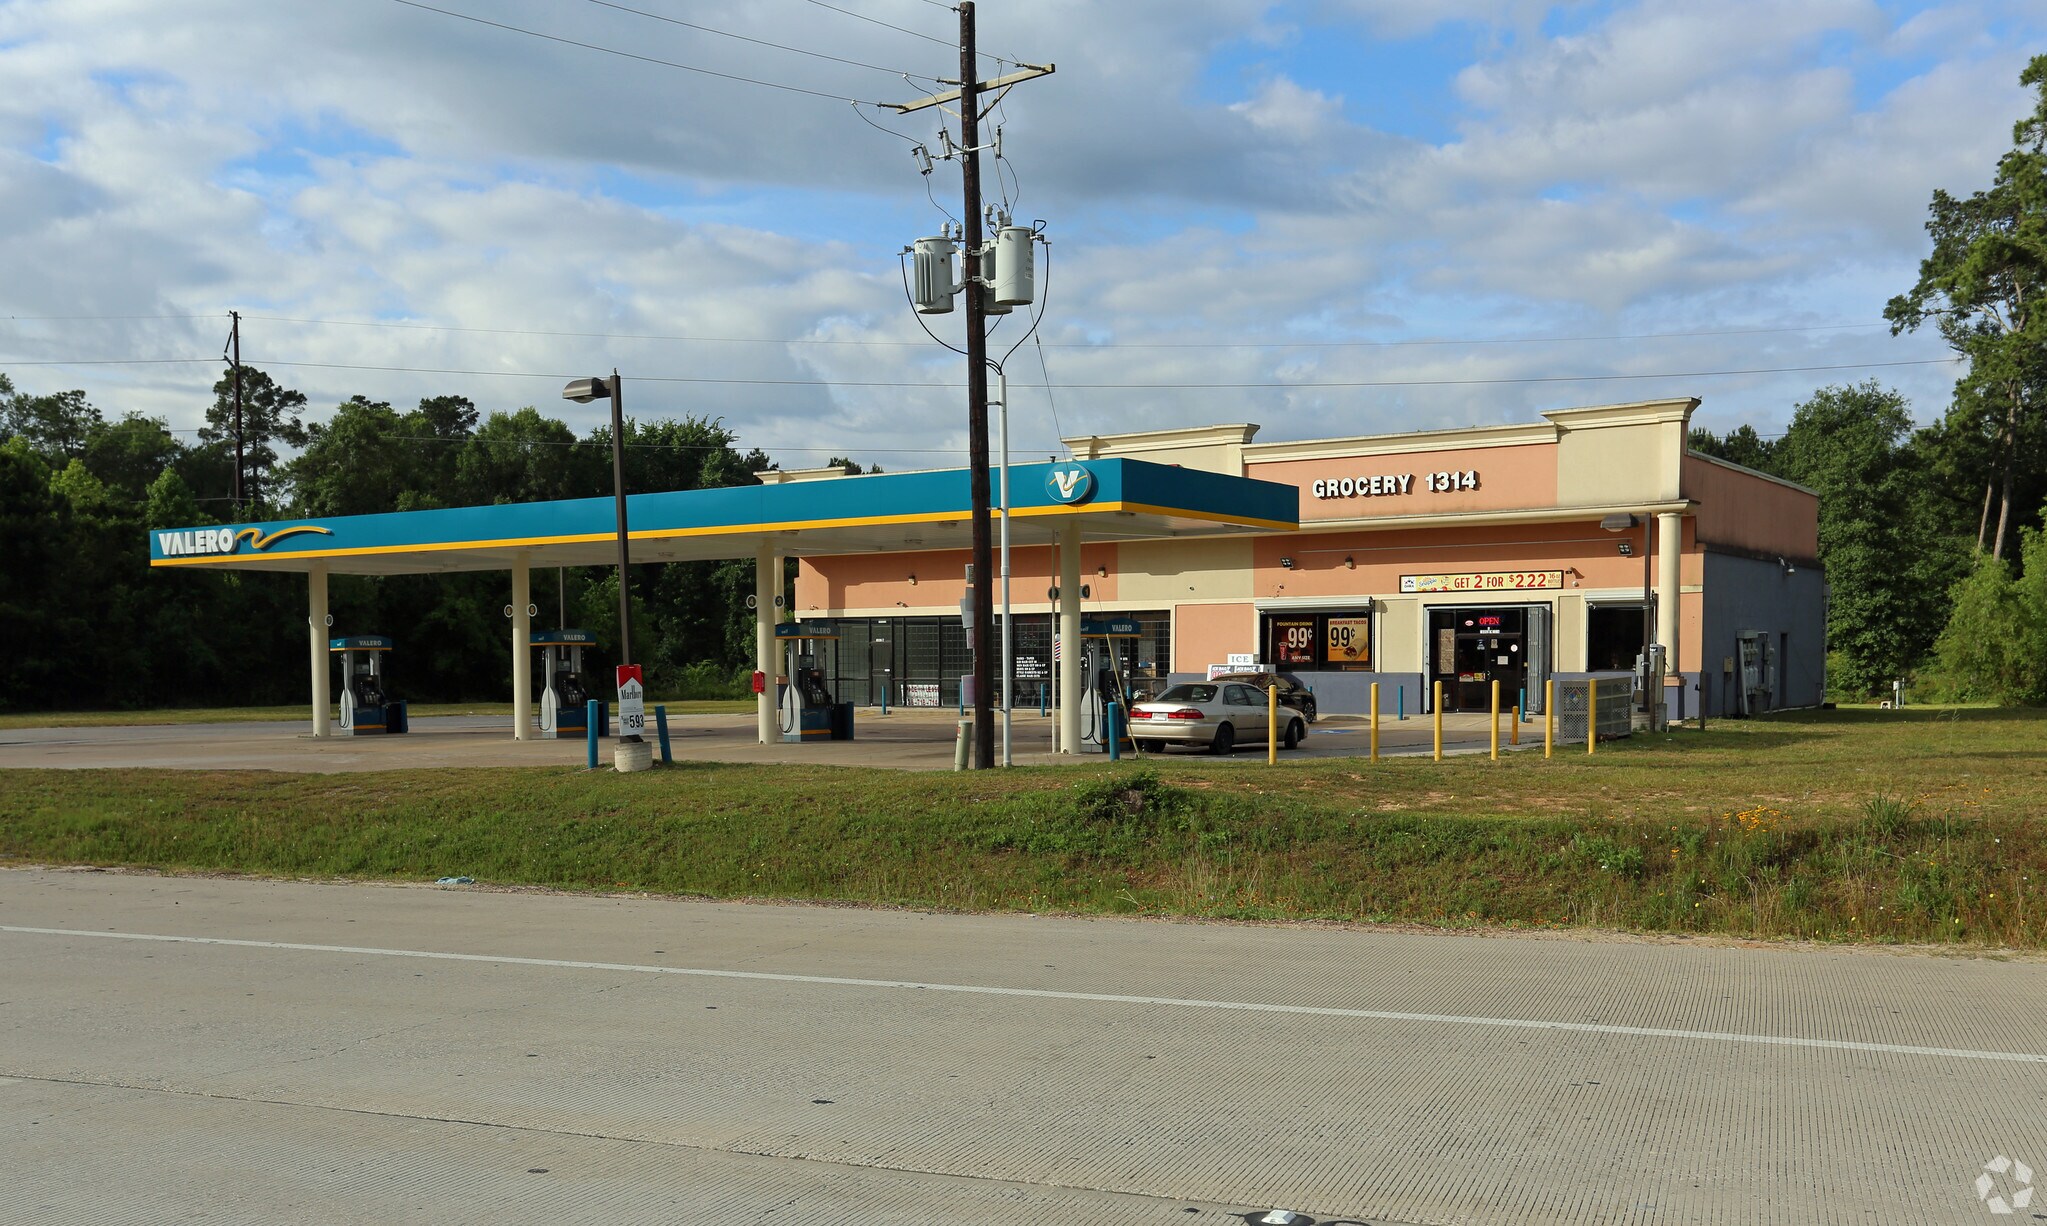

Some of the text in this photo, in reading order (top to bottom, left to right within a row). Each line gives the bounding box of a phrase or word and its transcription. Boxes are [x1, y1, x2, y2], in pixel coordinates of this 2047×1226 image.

[1312, 470, 1476, 498] GROCERY 1314
[158, 528, 234, 556] VALERO
[1454, 577, 1470, 588] GET
[1473, 575, 1483, 588] 2
[1486, 576, 1504, 588] FOR
[1508, 573, 1546, 588] $2.22
[1111, 624, 1133, 632] VALERO
[1479, 617, 1499, 625] OPEN
[1287, 627, 1313, 649] 99¢
[1330, 626, 1355, 647] 99¢
[1231, 655, 1249, 663] ICE
[621, 685, 641, 699] Marlbor
[629, 714, 644, 728] 593
